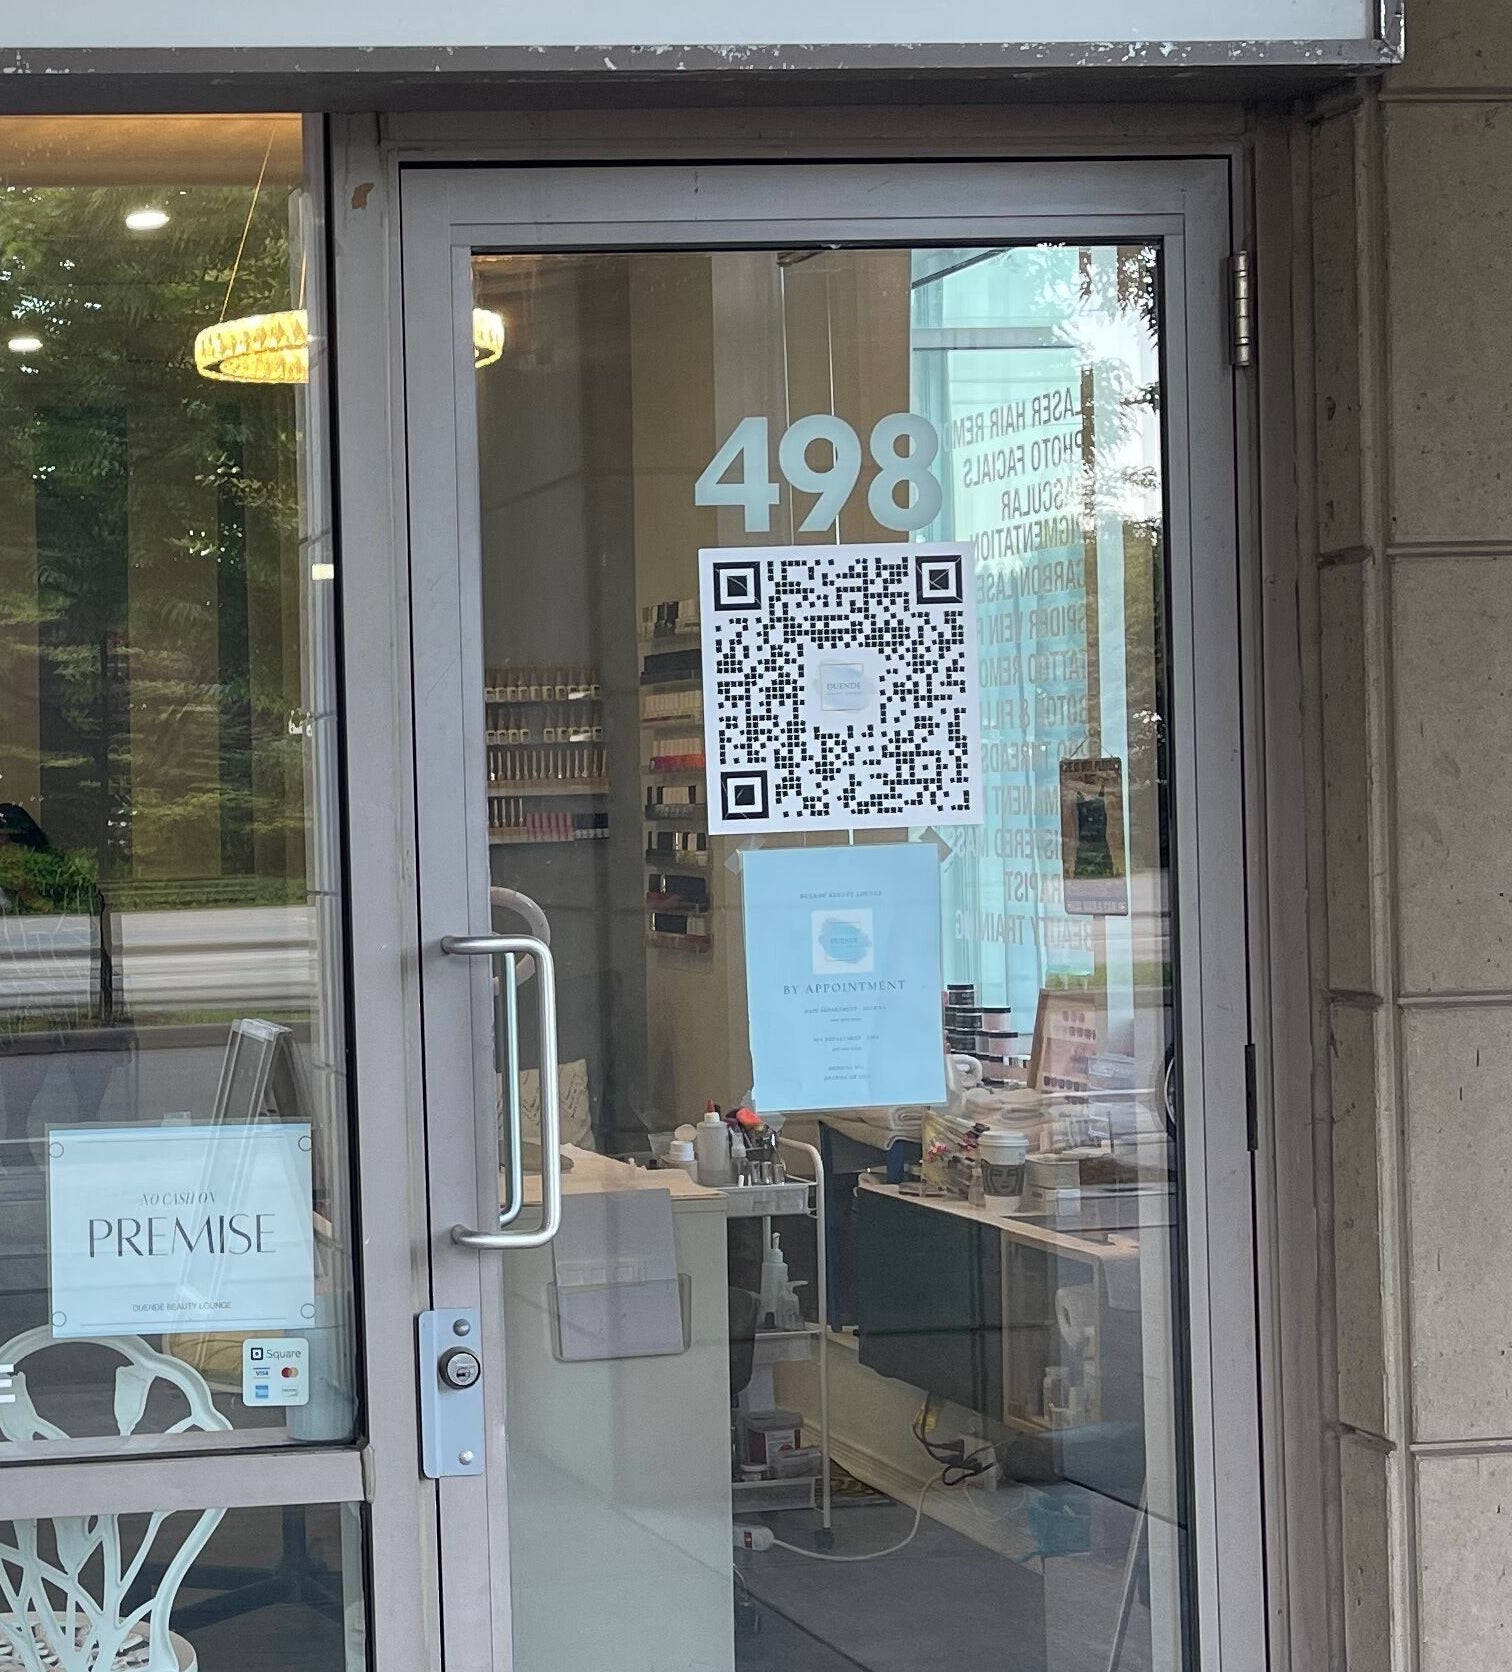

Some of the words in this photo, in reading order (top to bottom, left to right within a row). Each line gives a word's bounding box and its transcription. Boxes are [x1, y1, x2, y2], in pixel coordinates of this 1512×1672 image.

[694, 412, 942, 532] 498
[783, 983, 800, 995] BY
[805, 980, 906, 994] APPOINTMENT
[88, 1213, 276, 1258] PREMISE
[167, 1302, 197, 1311] BEAUTY
[266, 1348, 302, 1360] Square
